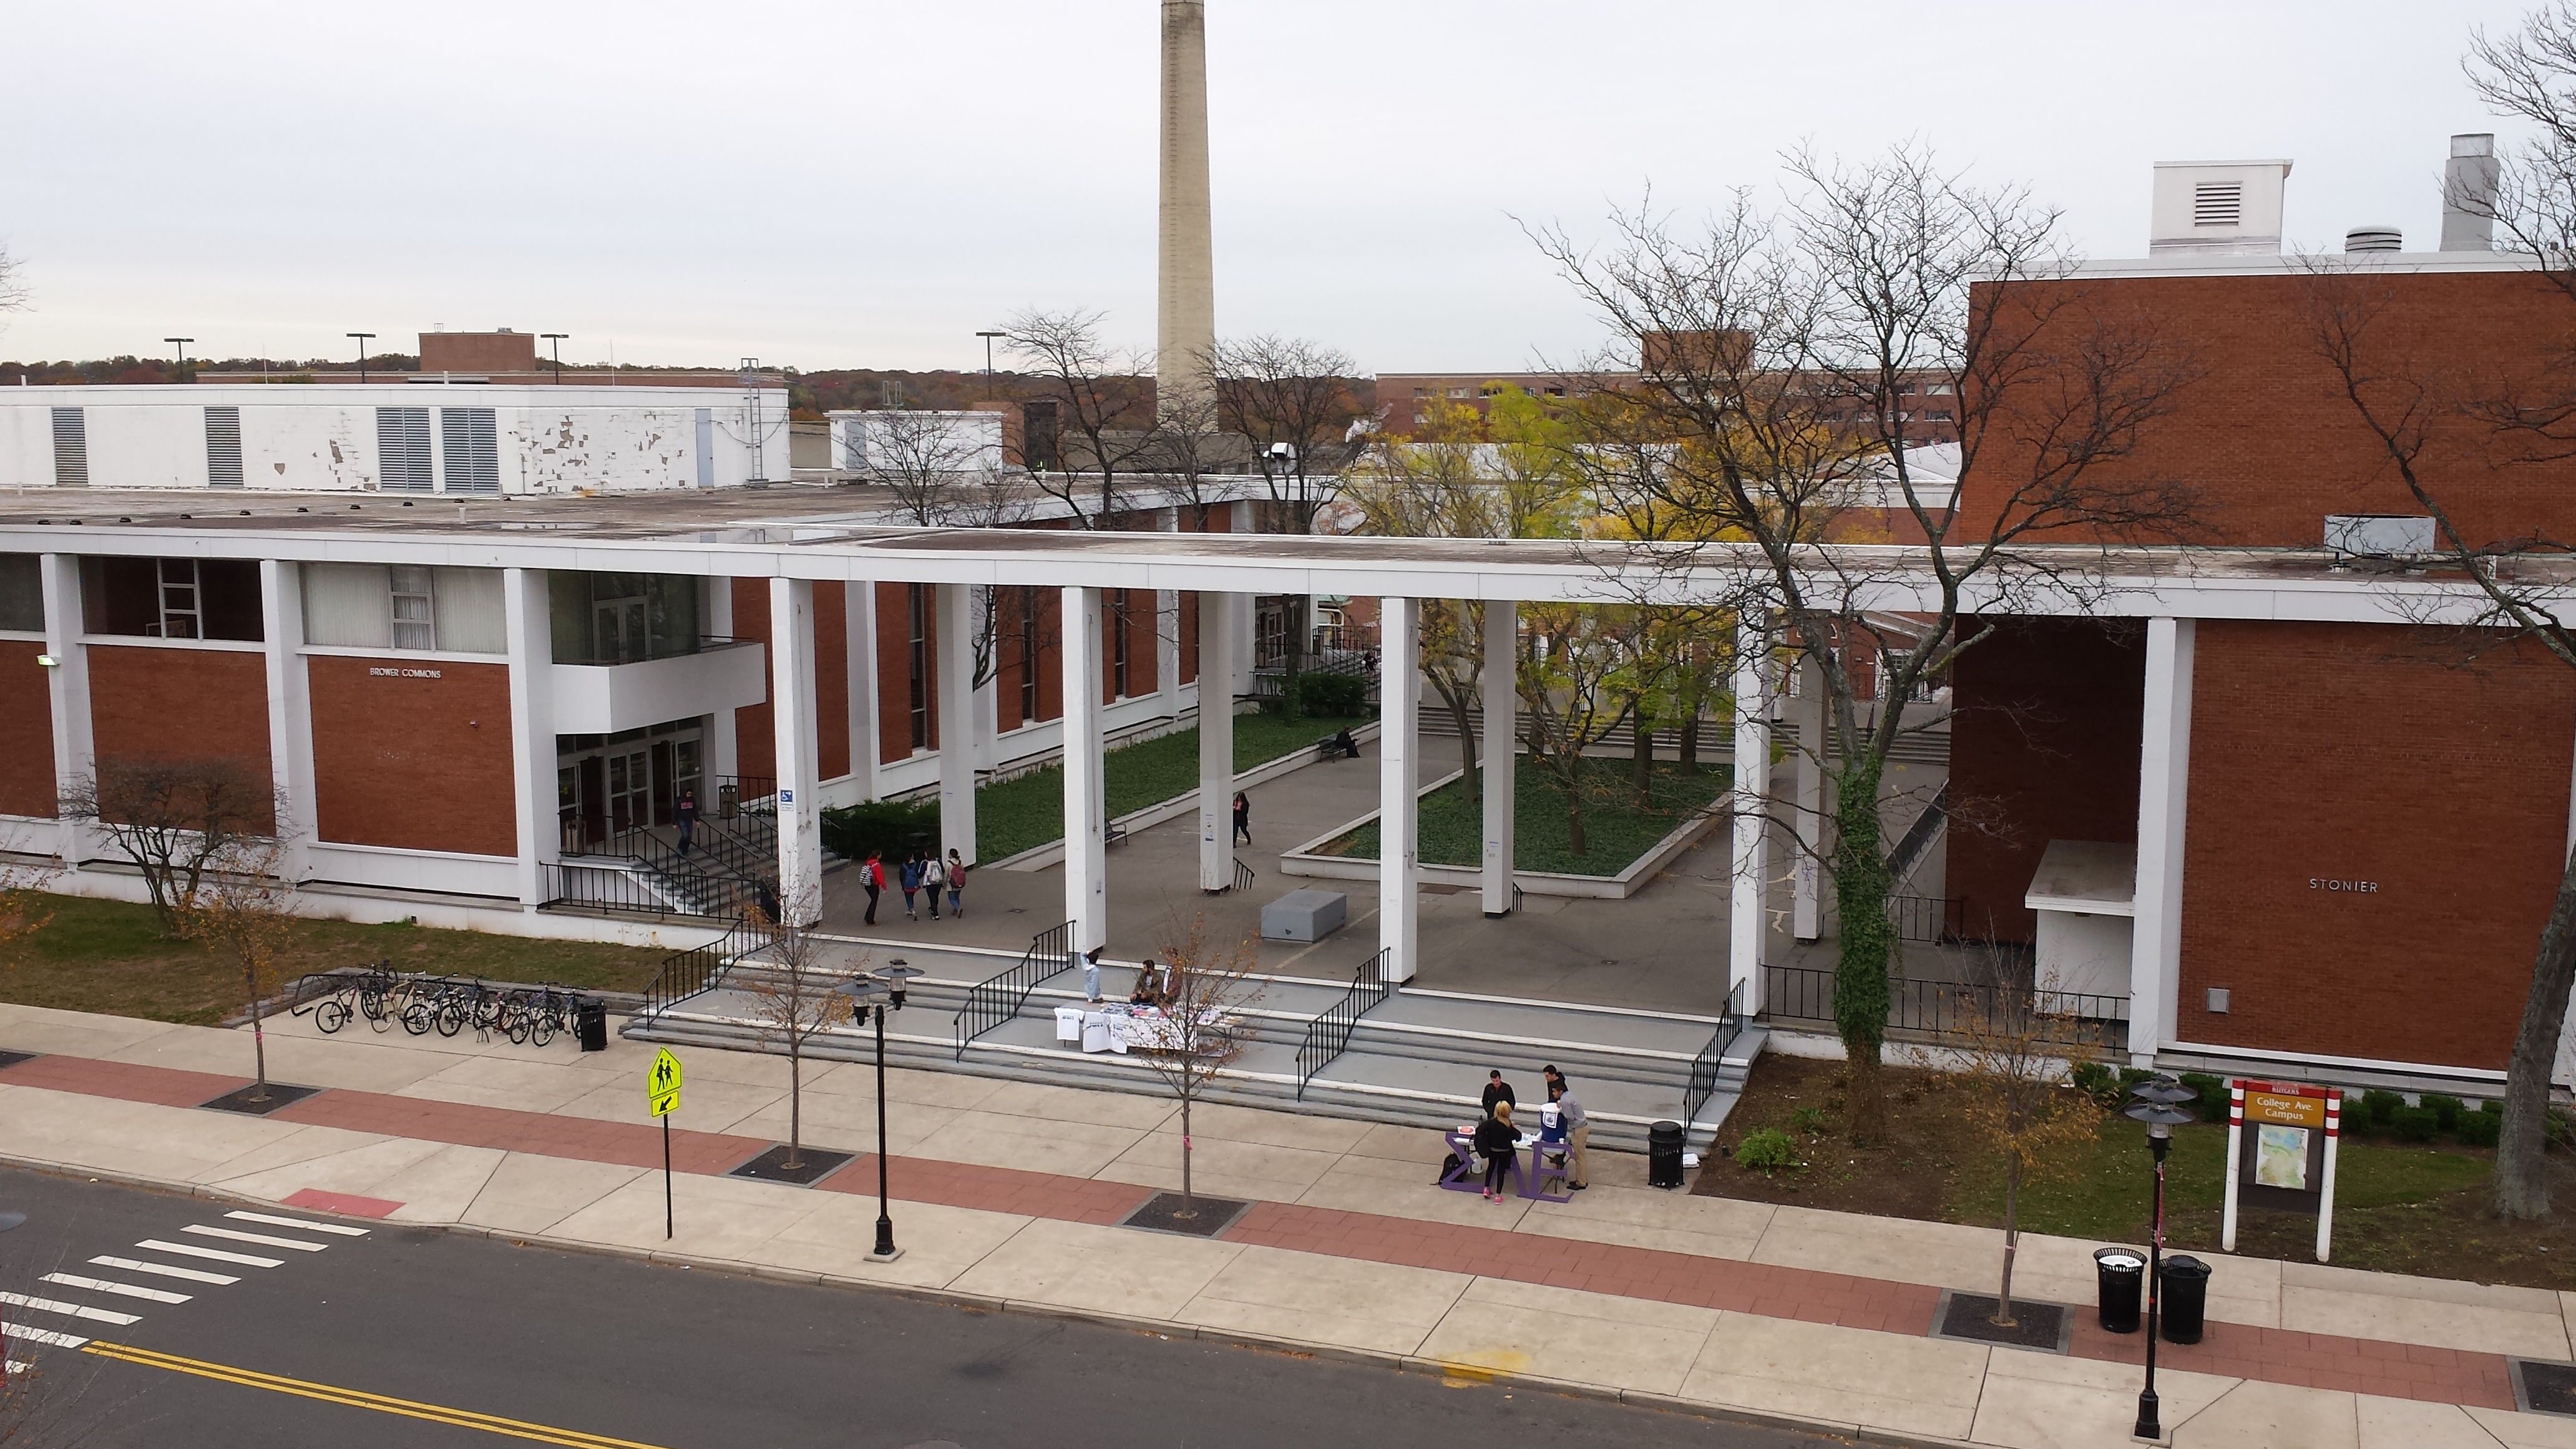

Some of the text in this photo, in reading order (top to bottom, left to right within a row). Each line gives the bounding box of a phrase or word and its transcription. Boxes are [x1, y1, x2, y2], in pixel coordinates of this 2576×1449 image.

[370, 667, 441, 679] BROWER COMMONS
[2310, 878, 2378, 893] STONIER
[2256, 1096, 2313, 1111] College Ave.
[2265, 1108, 2304, 1121] Campus
